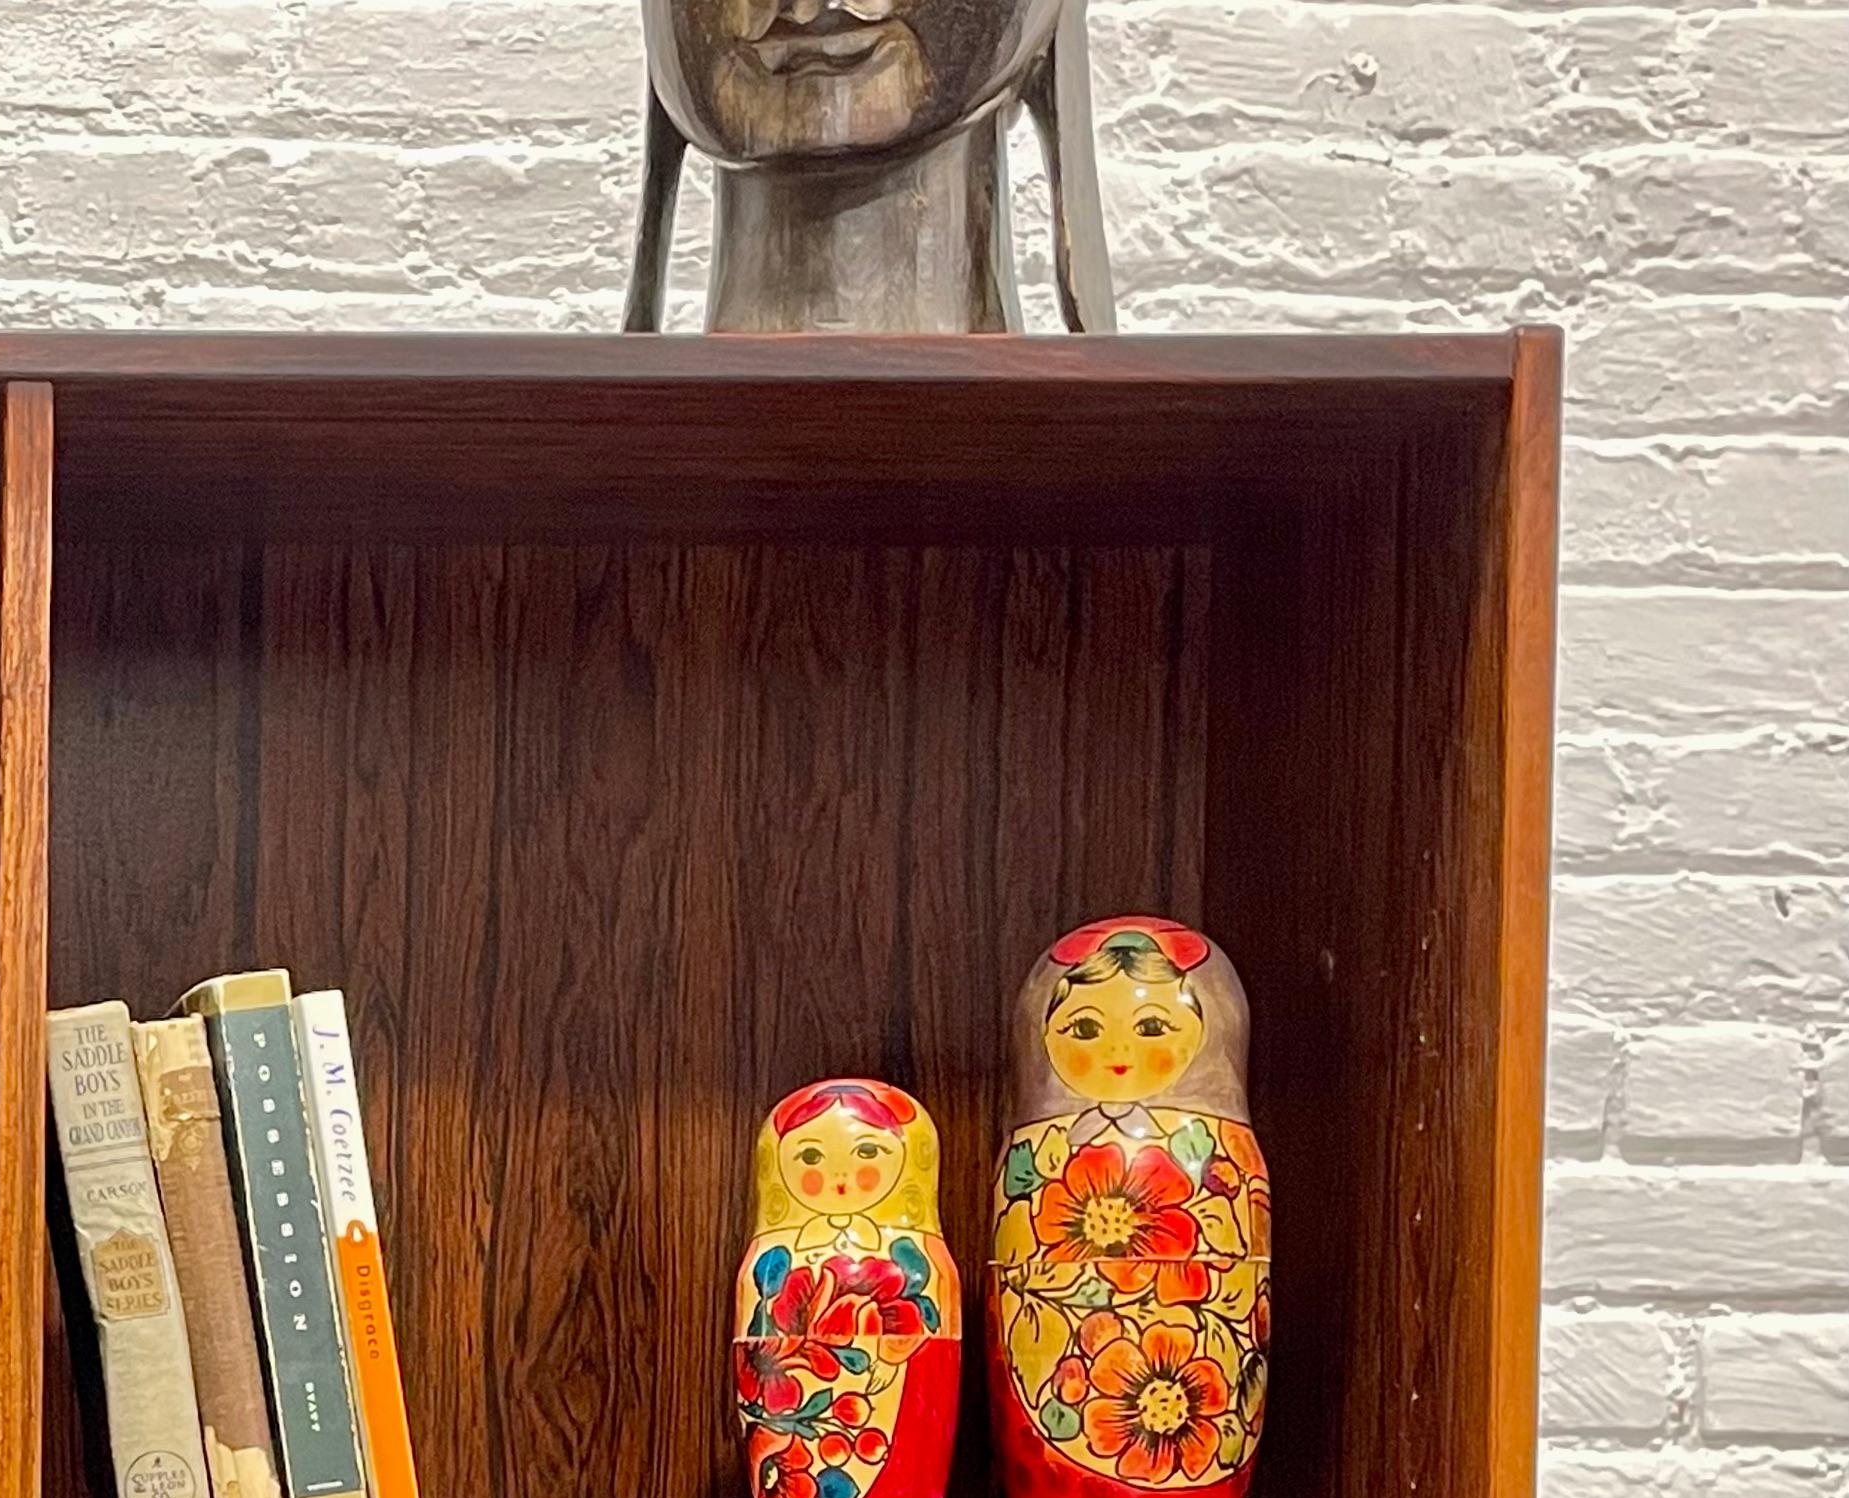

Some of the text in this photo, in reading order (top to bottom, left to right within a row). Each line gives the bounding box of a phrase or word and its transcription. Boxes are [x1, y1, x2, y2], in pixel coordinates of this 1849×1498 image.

[73, 1023, 108, 1045] THE
[62, 1042, 129, 1072] SADDLE
[73, 1069, 121, 1096] BOYS
[82, 1099, 126, 1120] IN THE
[312, 1024, 358, 1203] J. M. Coetzee
[86, 1180, 148, 1201] CARSON
[98, 1252, 157, 1274] SADDLE
[108, 1273, 154, 1293] BOYS
[106, 1291, 163, 1312] SERIES
